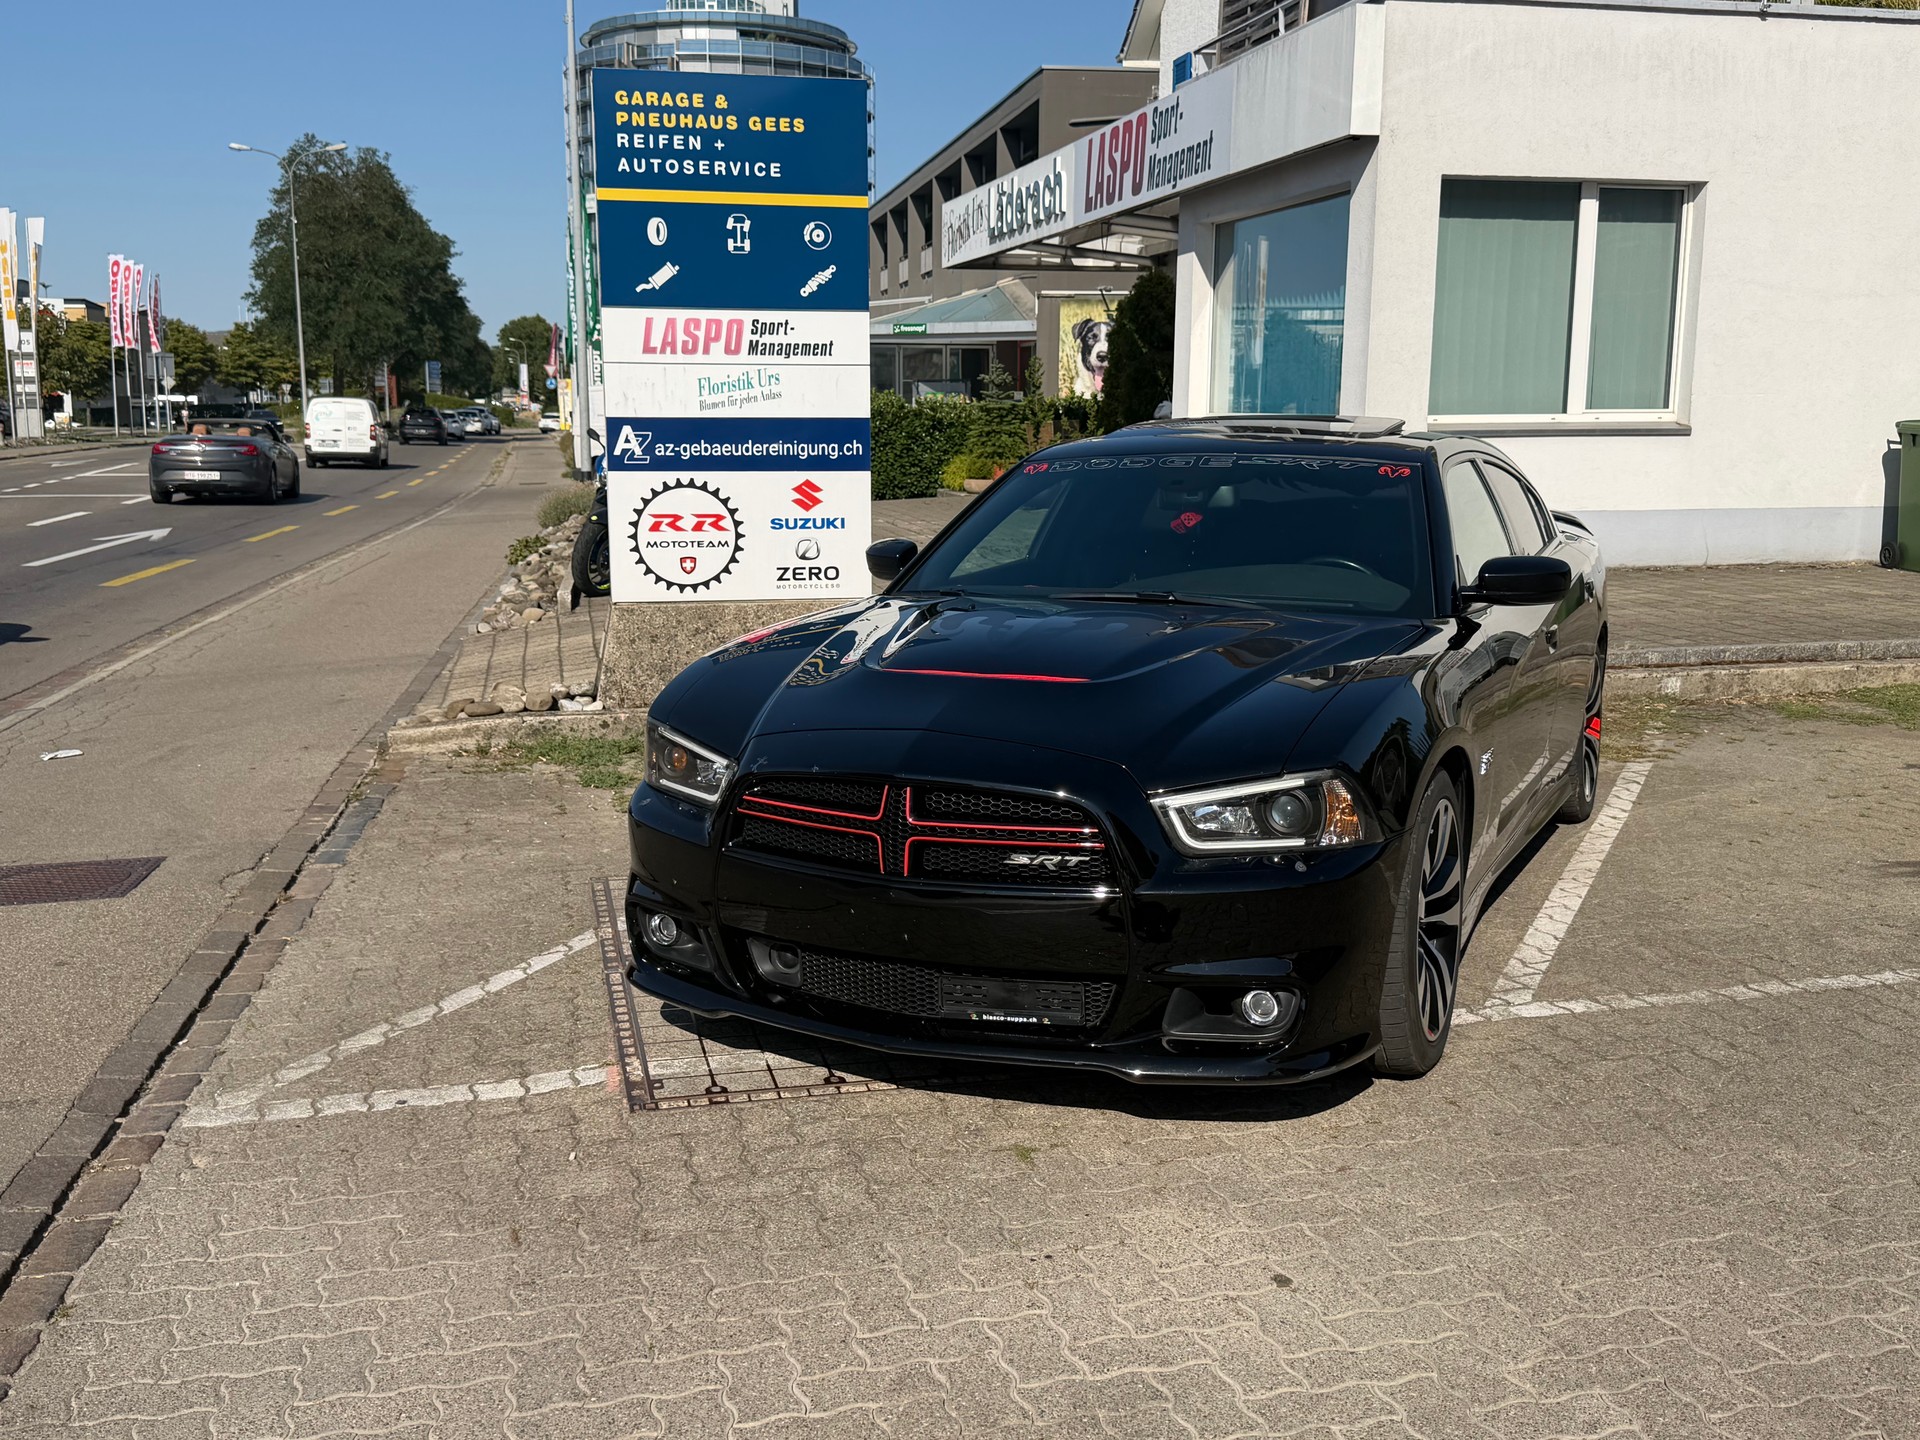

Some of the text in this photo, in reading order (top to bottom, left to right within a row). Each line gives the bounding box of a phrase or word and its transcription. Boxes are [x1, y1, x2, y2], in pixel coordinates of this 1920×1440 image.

[615, 90, 728, 109] GARAGE &
[615, 111, 806, 133] PNEUHAUS GEES
[1150, 95, 1184, 146] Sport-
[616, 133, 725, 151] REIFEN +
[617, 157, 782, 178] AUTOSERVICE
[1084, 111, 1148, 214] LASPO
[1146, 130, 1214, 193] Management
[988, 156, 1067, 242] Läderach
[642, 317, 745, 356] LASPO
[750, 319, 795, 338] Sport-
[747, 339, 834, 359] Management
[697, 368, 781, 397] Floristik Urs
[699, 390, 783, 412] Blumen für jeden Anlass
[655, 439, 863, 460] az-gebaeudereinigung.ch
[1049, 456, 1381, 474] DODGE SRT
[647, 513, 732, 533] RR
[769, 517, 845, 530] SUZUKI
[646, 539, 730, 549] MOTOTEAM
[776, 566, 840, 582] ZERO
[1003, 853, 1091, 871] SRT
